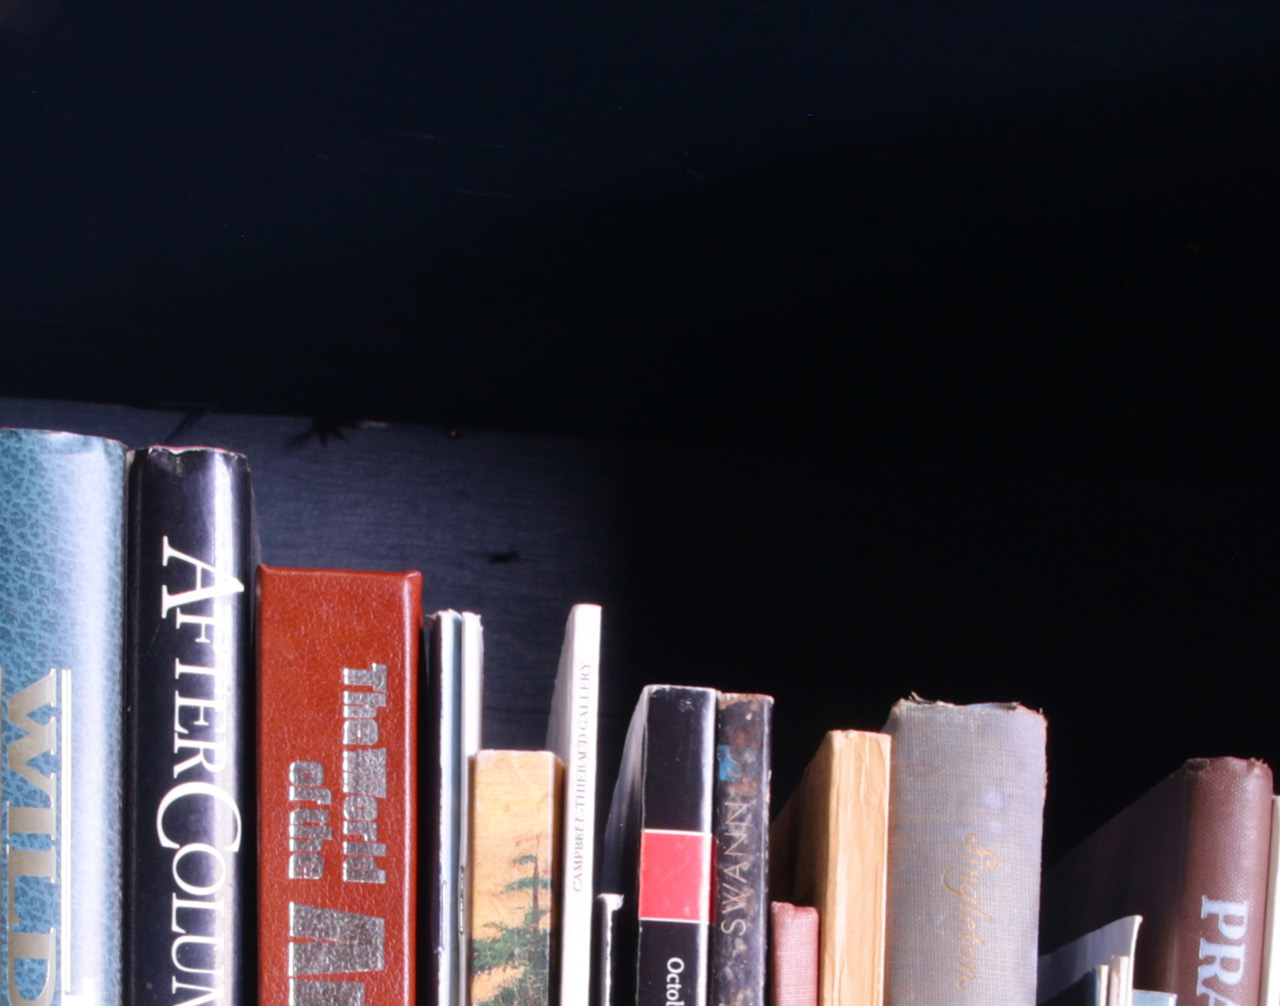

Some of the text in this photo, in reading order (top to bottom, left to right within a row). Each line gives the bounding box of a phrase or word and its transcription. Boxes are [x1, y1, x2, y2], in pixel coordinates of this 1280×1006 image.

[162, 537, 244, 778] AFTER
[289, 760, 333, 881] of the
[342, 662, 387, 884] The World
[721, 800, 747, 934] SWANN
[940, 832, 998, 990] Singleton
